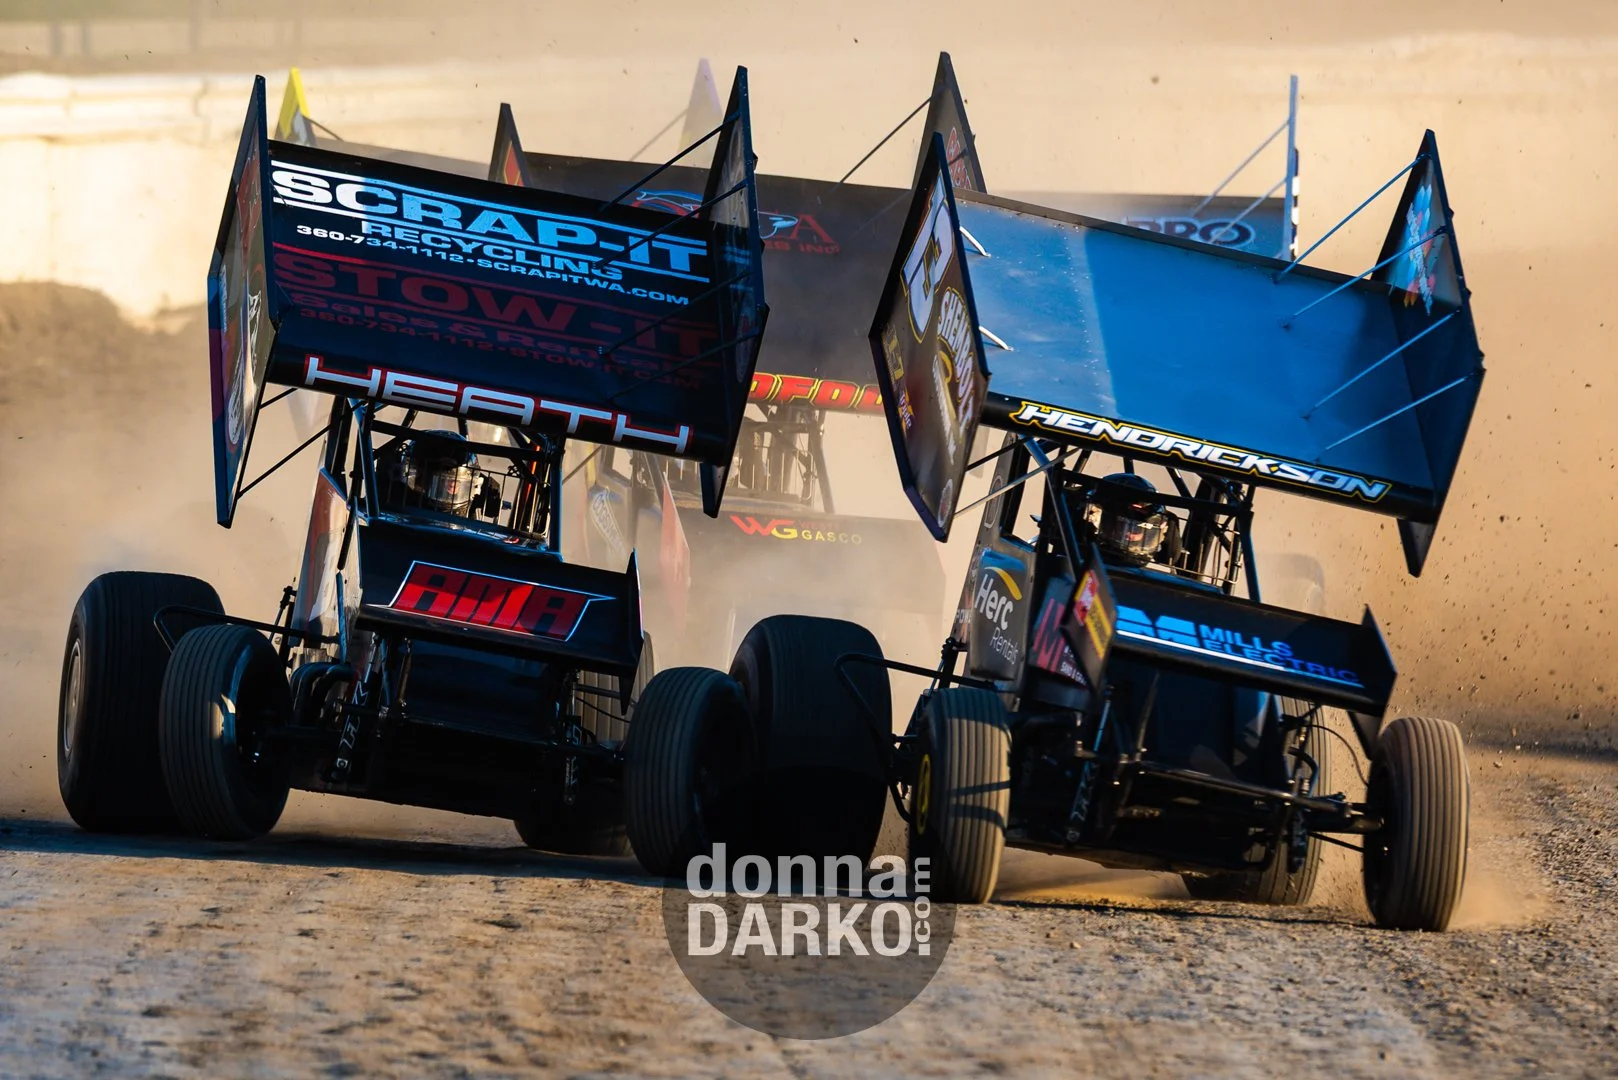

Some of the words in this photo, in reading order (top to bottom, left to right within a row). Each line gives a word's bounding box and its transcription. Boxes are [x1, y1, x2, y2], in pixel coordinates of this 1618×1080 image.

[271, 170, 708, 272] SCRAP-IT
[361, 219, 623, 281] RECYCLING
[273, 252, 719, 356] STOW-IT
[290, 293, 442, 331] Sales
[304, 355, 692, 454] HEATH
[1010, 401, 1393, 503] HENDRICKSON
[801, 529, 863, 545] GASCO
[974, 573, 1014, 631] Herc
[989, 626, 1019, 665] Rentals
[1199, 623, 1294, 658] MILLS
[1202, 639, 1361, 682] ELECTRIC
